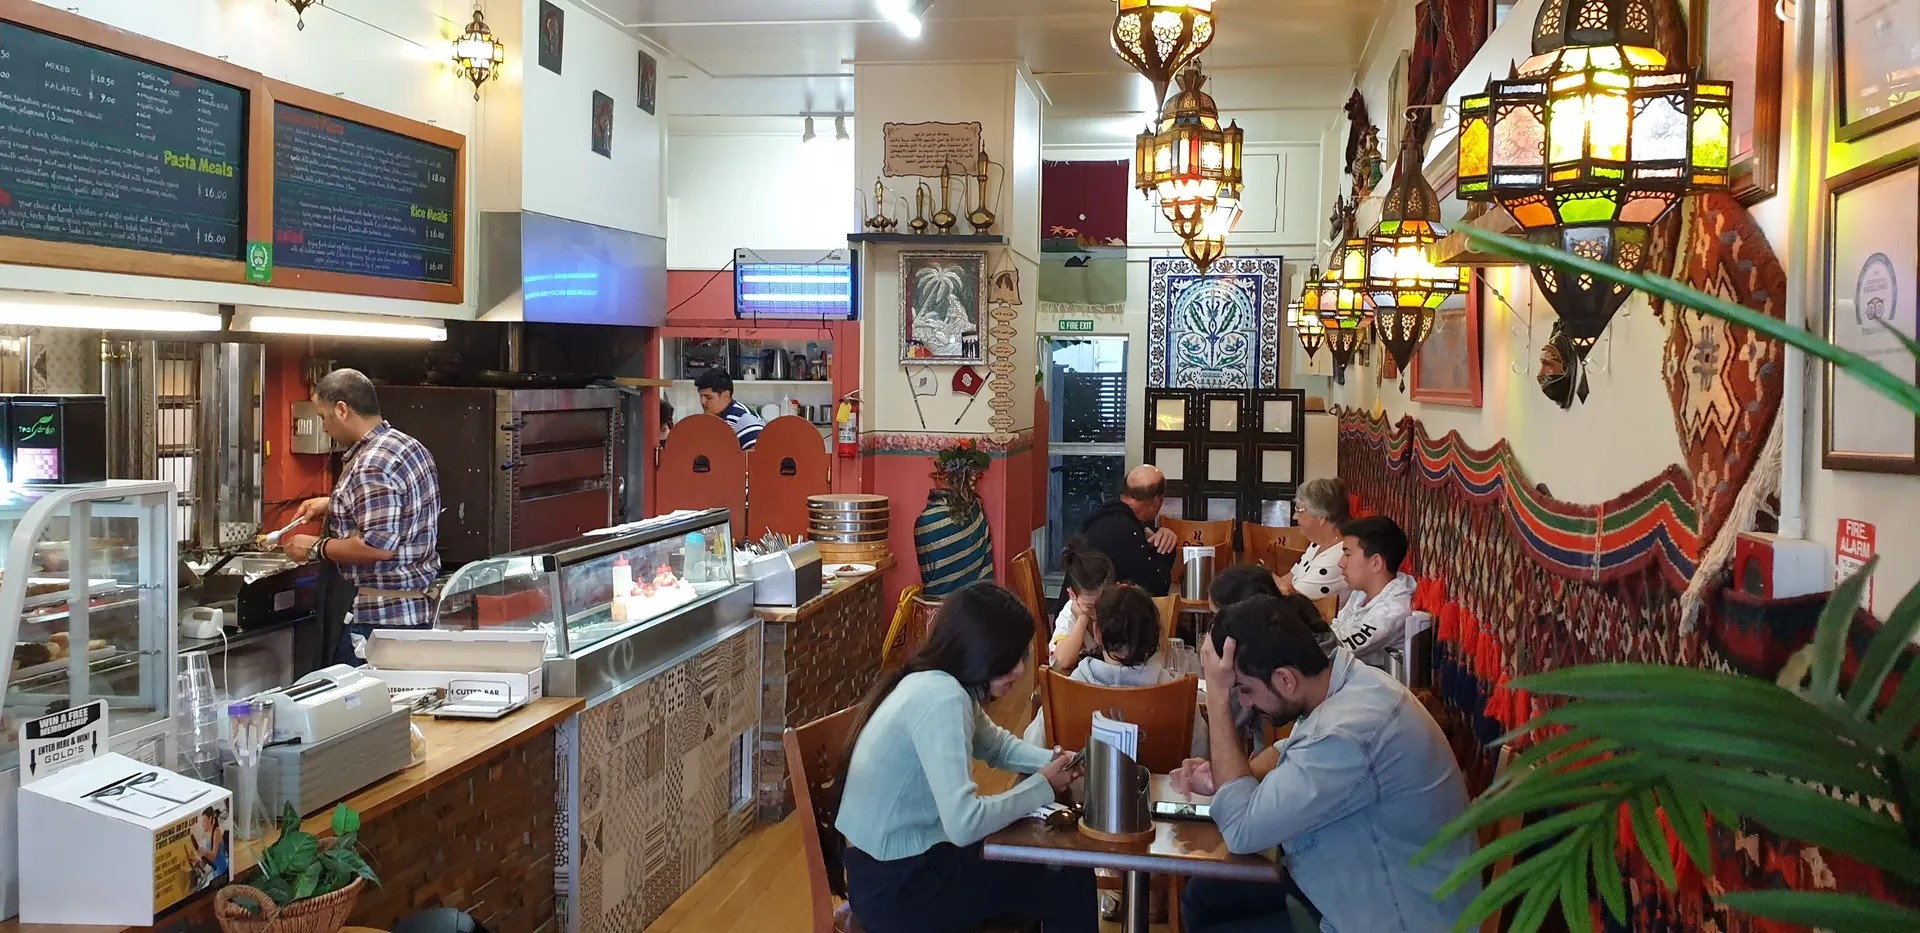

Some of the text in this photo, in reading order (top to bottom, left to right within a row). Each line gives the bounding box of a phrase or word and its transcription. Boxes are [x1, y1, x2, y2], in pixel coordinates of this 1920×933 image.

[45, 61, 70, 73] MIXED
[45, 81, 81, 96] FALAFEL
[100, 94, 115, 103] 9.00
[164, 150, 196, 170] Pasta
[199, 157, 233, 177] Meals
[205, 187, 227, 199] 16.00
[410, 203, 426, 218] Rice
[427, 207, 448, 223] Meals
[204, 232, 226, 244] 16.00
[1067, 321, 1092, 330] FIRE EXIT
[1846, 520, 1868, 539] FIRE
[1840, 537, 1870, 558] ALARM
[39, 707, 88, 728] WIN A FREE
[40, 716, 88, 736] MEMBERSHIP
[38, 743, 55, 755] ENTER
[57, 738, 70, 750] HERE
[71, 736, 75, 746] &
[45, 745, 84, 764] GOLD'S
[156, 816, 198, 841] SPRING INTO LIFE
[156, 828, 190, 851] THIS SUMMER
